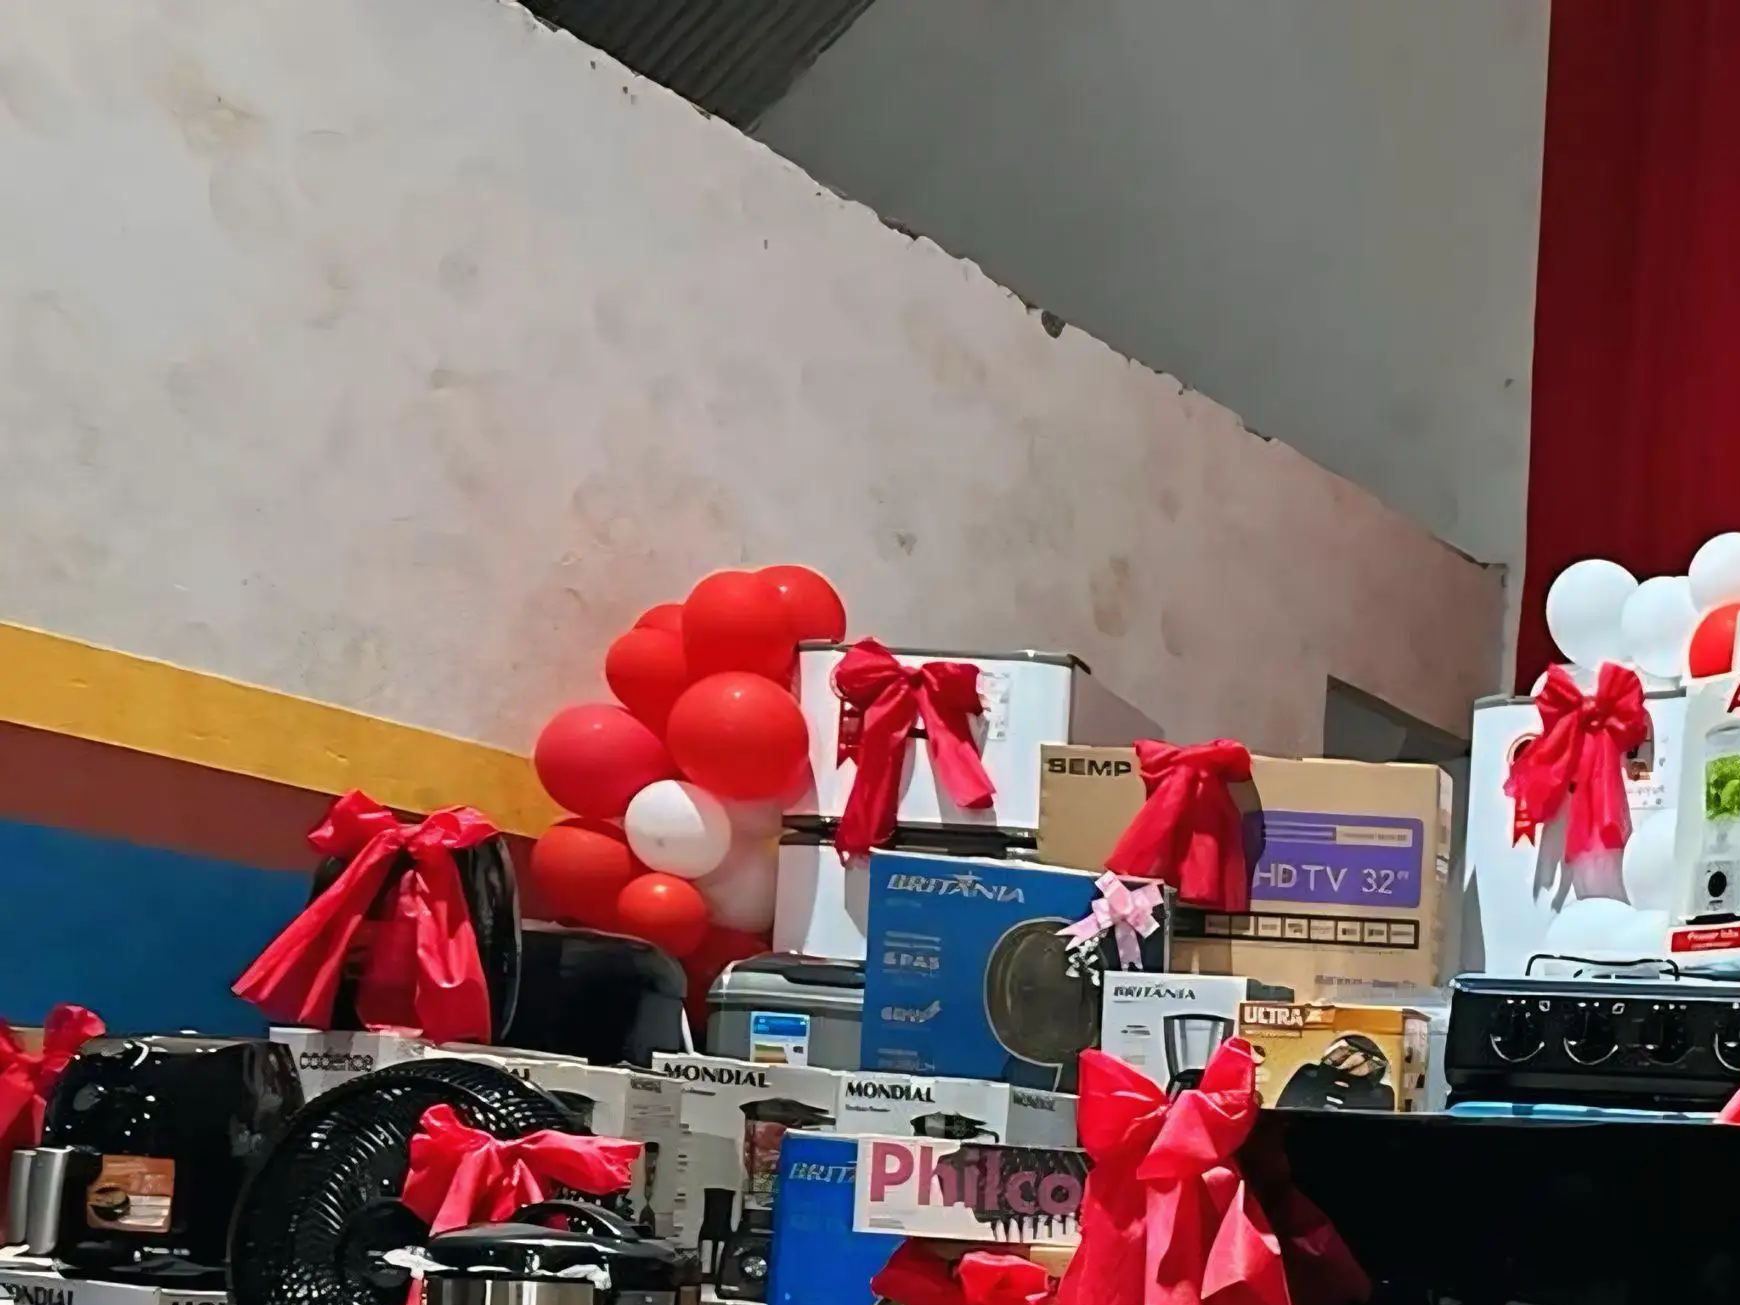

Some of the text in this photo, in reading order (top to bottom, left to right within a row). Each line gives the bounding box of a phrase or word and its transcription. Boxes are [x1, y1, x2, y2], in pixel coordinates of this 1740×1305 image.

[1047, 757, 1132, 777] SEMP
[1301, 864, 1348, 893] TV
[1243, 1006, 1304, 1027] ULTRA
[662, 1061, 770, 1089] MONDIAL
[845, 1081, 936, 1104] MONDIAL
[869, 1141, 1082, 1216] Philco
